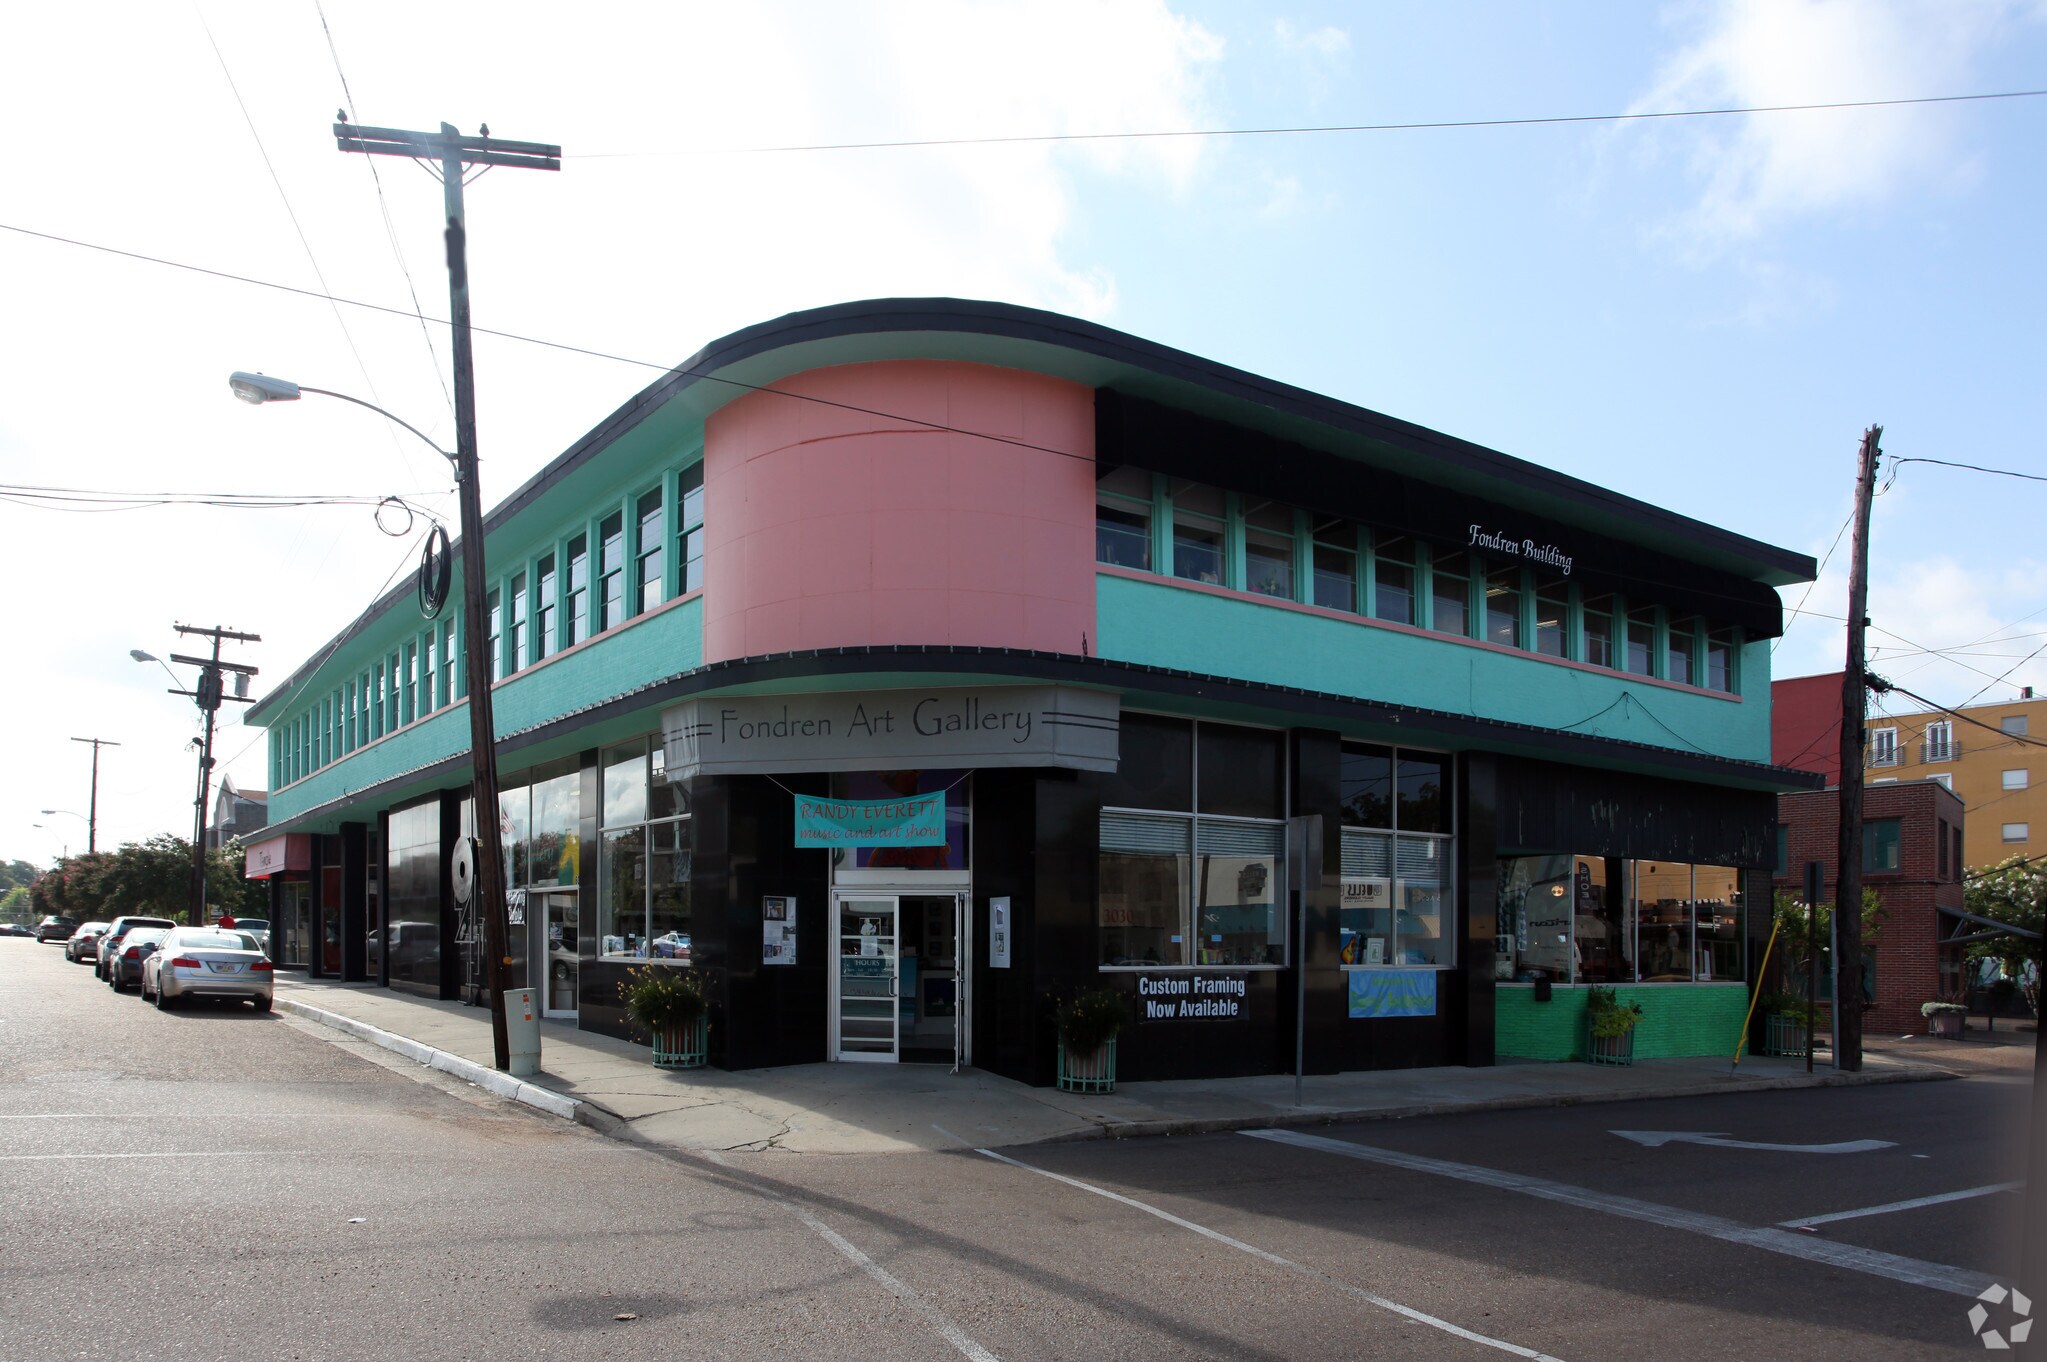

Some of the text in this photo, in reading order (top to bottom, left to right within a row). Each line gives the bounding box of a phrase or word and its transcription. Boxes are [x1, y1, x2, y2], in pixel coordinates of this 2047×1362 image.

[1467, 524, 1573, 576] Fondren Building
[720, 696, 1032, 744] Fondren Art Gallery
[801, 799, 939, 820] RANDY EVERETT
[800, 823, 940, 839] music and art show
[1103, 908, 1136, 924] 3030
[855, 959, 880, 967] HOURS
[1139, 976, 1246, 998] Custom Framing
[1146, 998, 1239, 1019] Now Available
